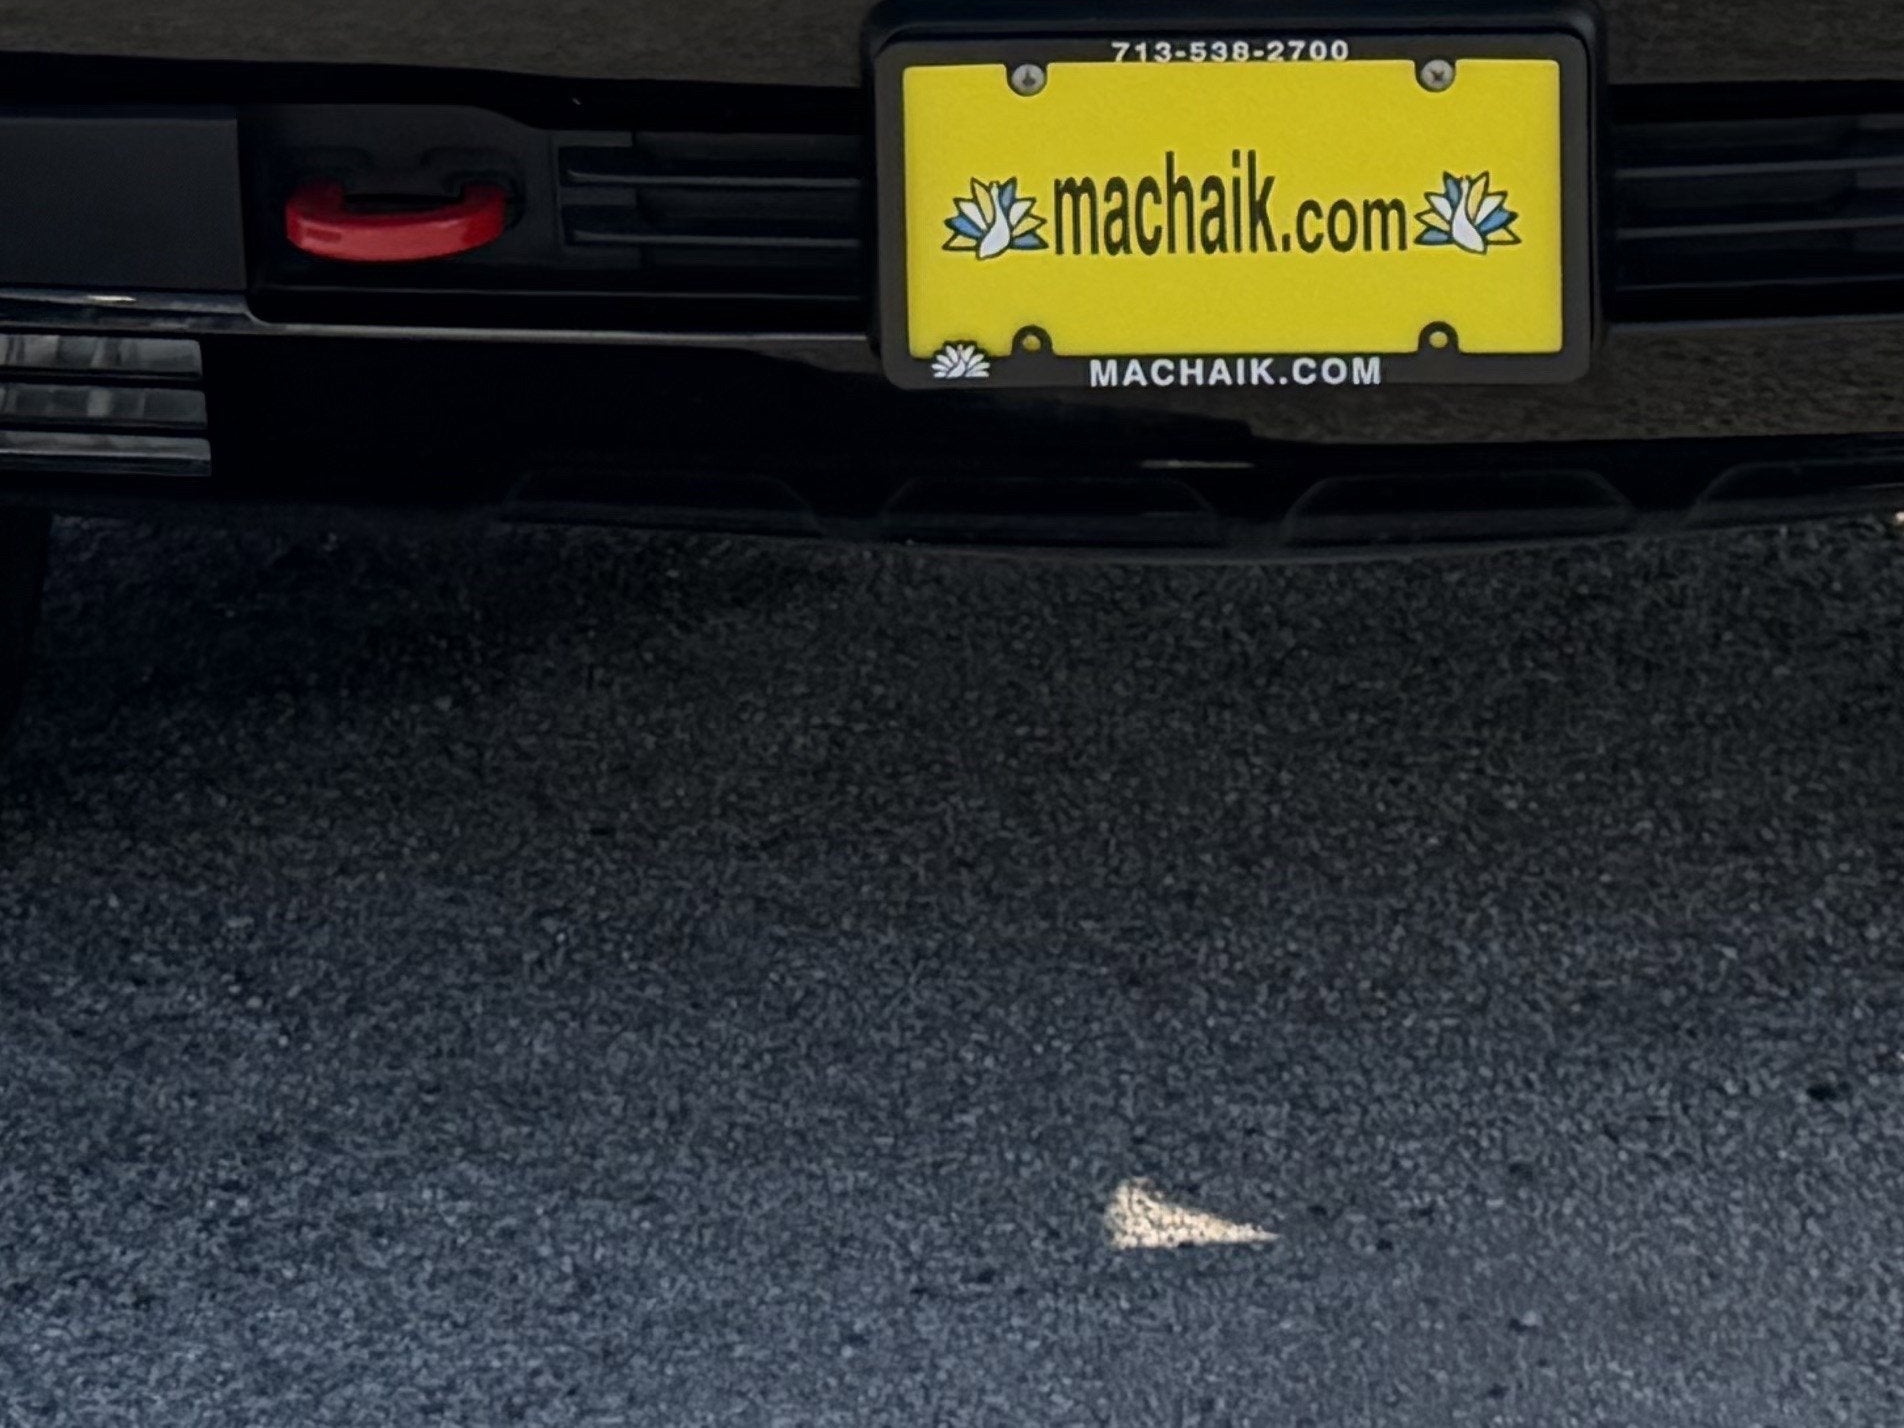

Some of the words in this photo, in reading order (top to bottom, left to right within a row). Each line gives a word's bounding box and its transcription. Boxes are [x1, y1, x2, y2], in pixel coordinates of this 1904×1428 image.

[1110, 40, 1349, 63] 713-538-2700
[1053, 148, 1408, 256] machaik.com
[1089, 356, 1382, 387] MACHAIK.COM
